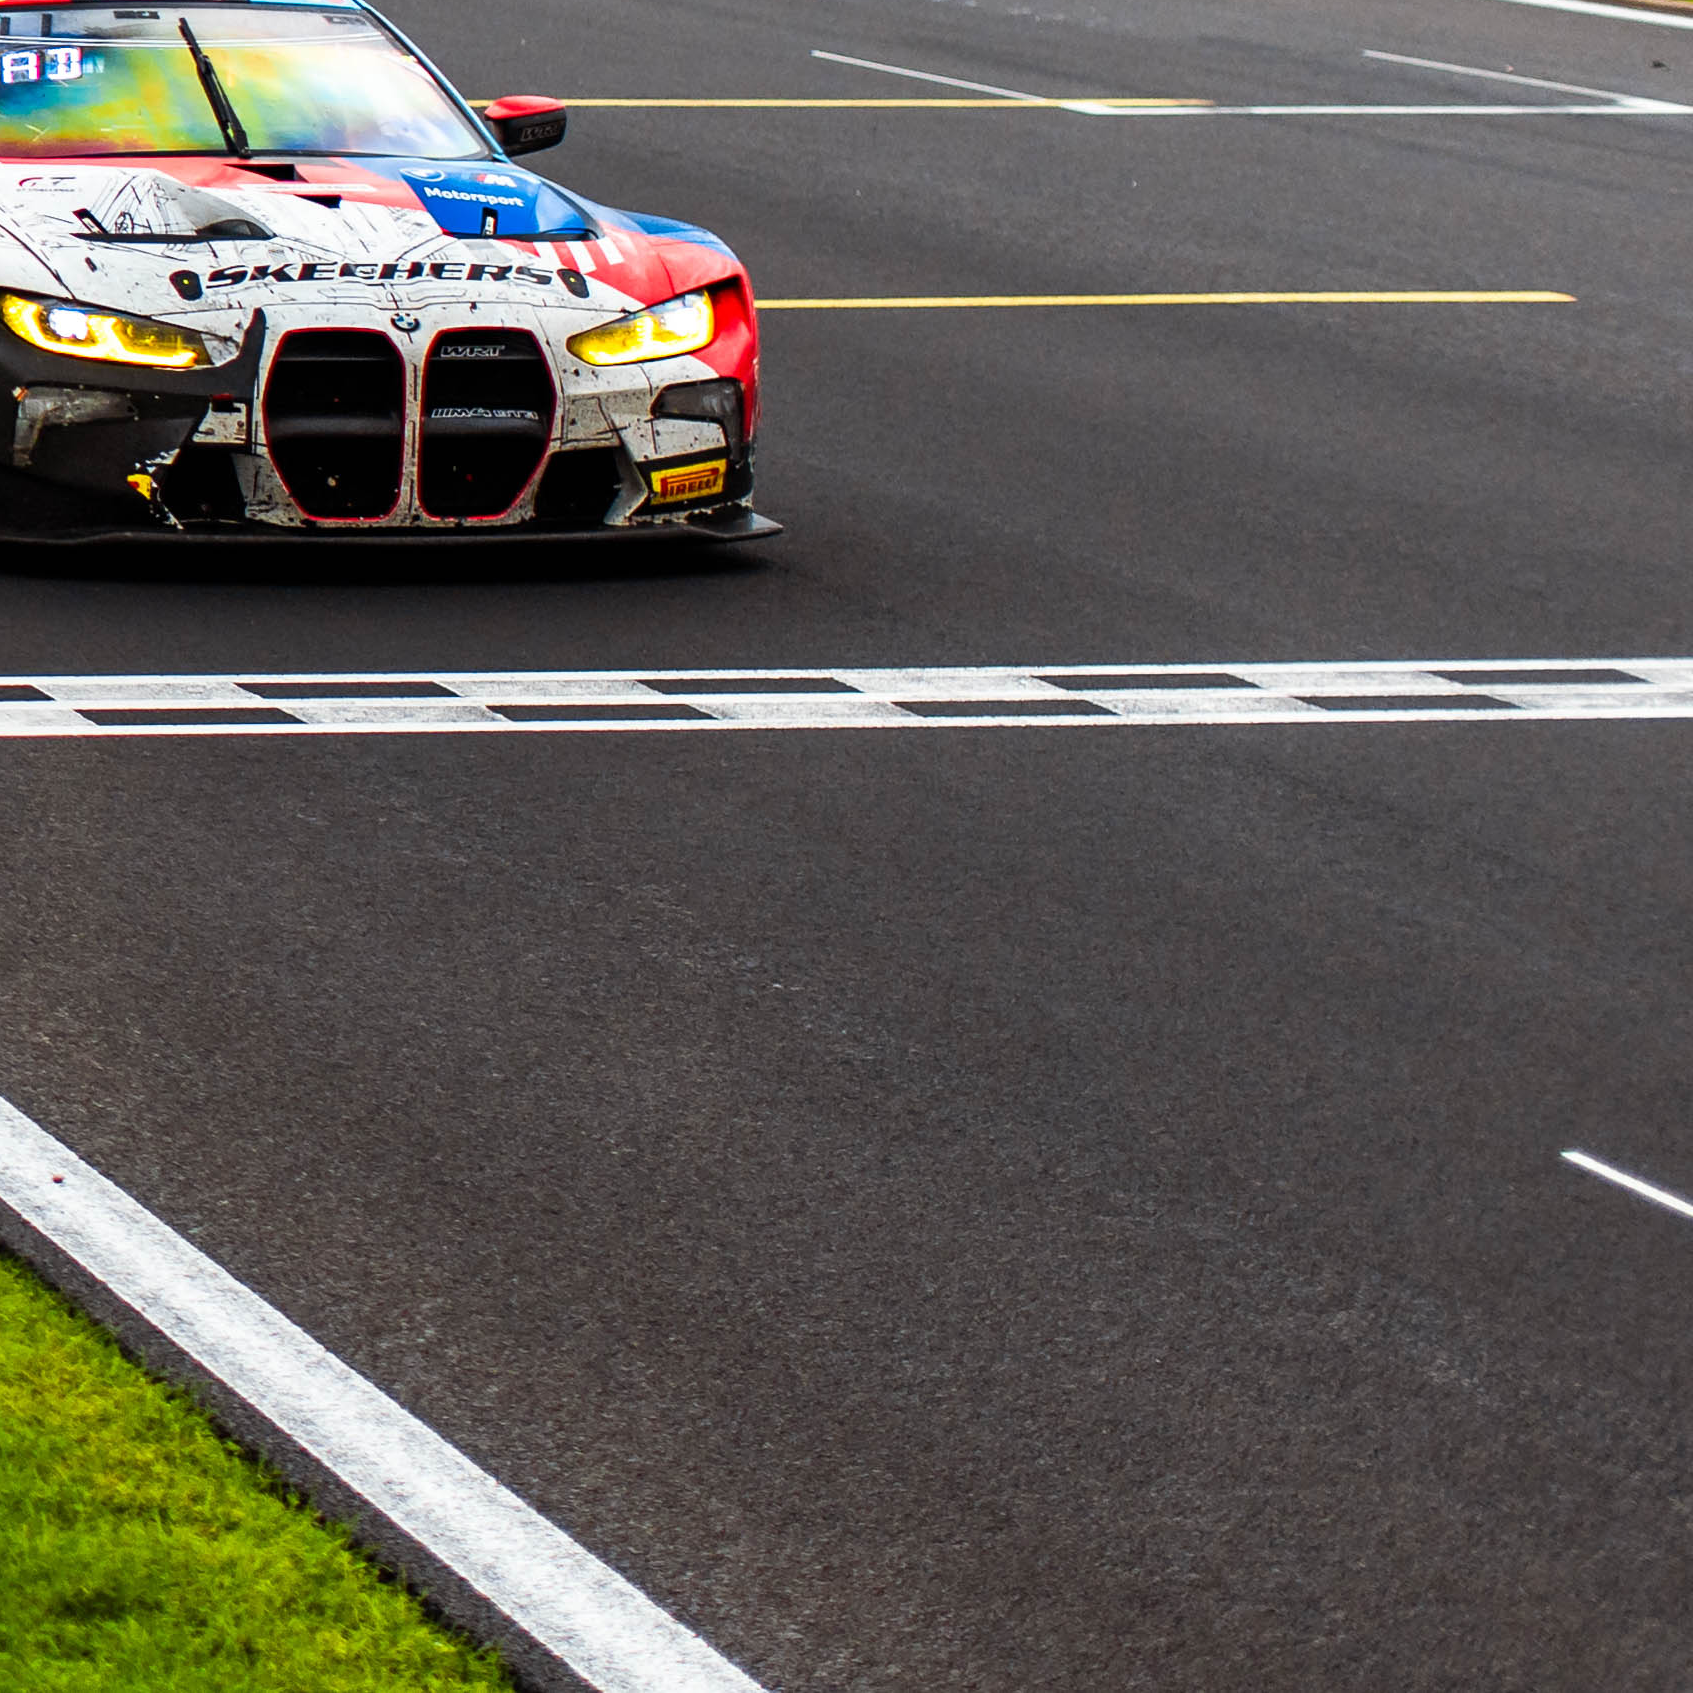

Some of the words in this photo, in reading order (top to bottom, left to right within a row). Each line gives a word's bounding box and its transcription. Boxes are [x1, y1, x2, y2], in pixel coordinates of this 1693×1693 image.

[424, 186, 525, 207] Motorsport
[206, 260, 554, 289] SKECHERS
[440, 345, 504, 358] WRT
[660, 467, 720, 499] PIRELLI
